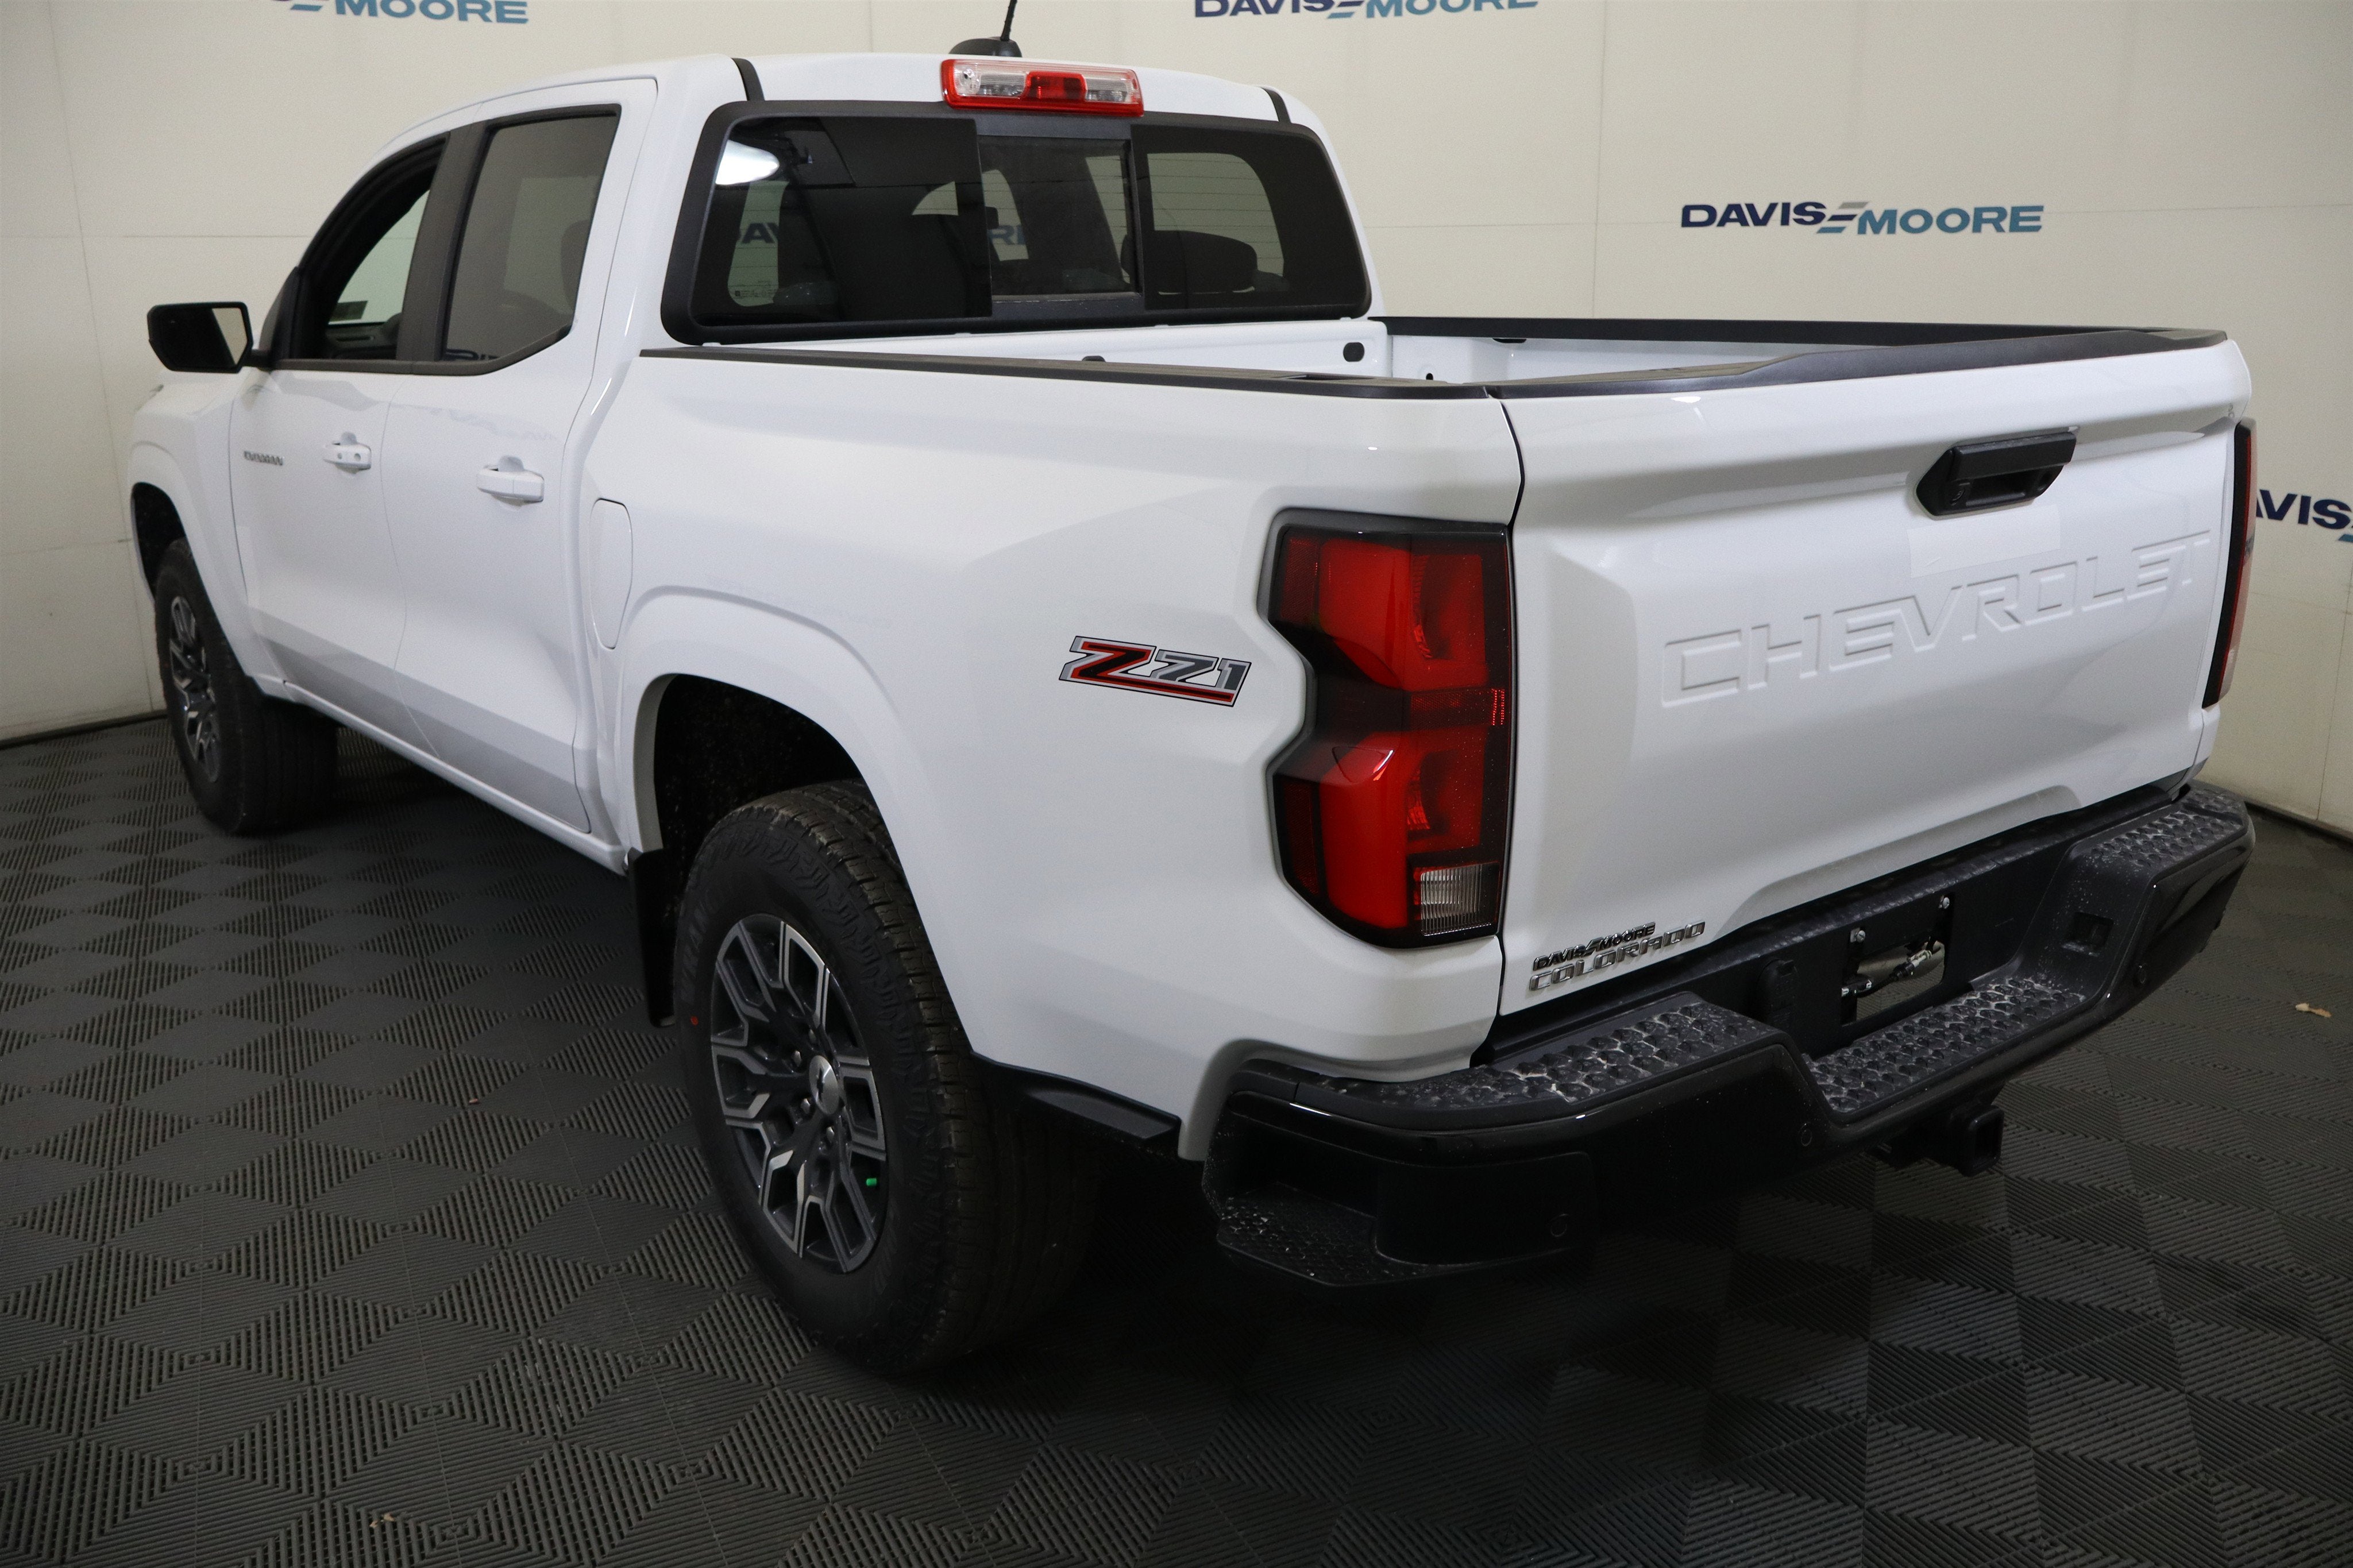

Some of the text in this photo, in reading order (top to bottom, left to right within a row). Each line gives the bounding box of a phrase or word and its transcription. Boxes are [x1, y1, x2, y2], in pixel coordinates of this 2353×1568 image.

[335, 0, 529, 24] MOORE
[1681, 201, 2045, 234] DAVIS MOORE
[2256, 489, 2352, 530] VIS
[1660, 530, 2211, 708] CHEVROLET
[1058, 635, 1252, 708] Z71
[1529, 920, 1706, 991] COLORADO
